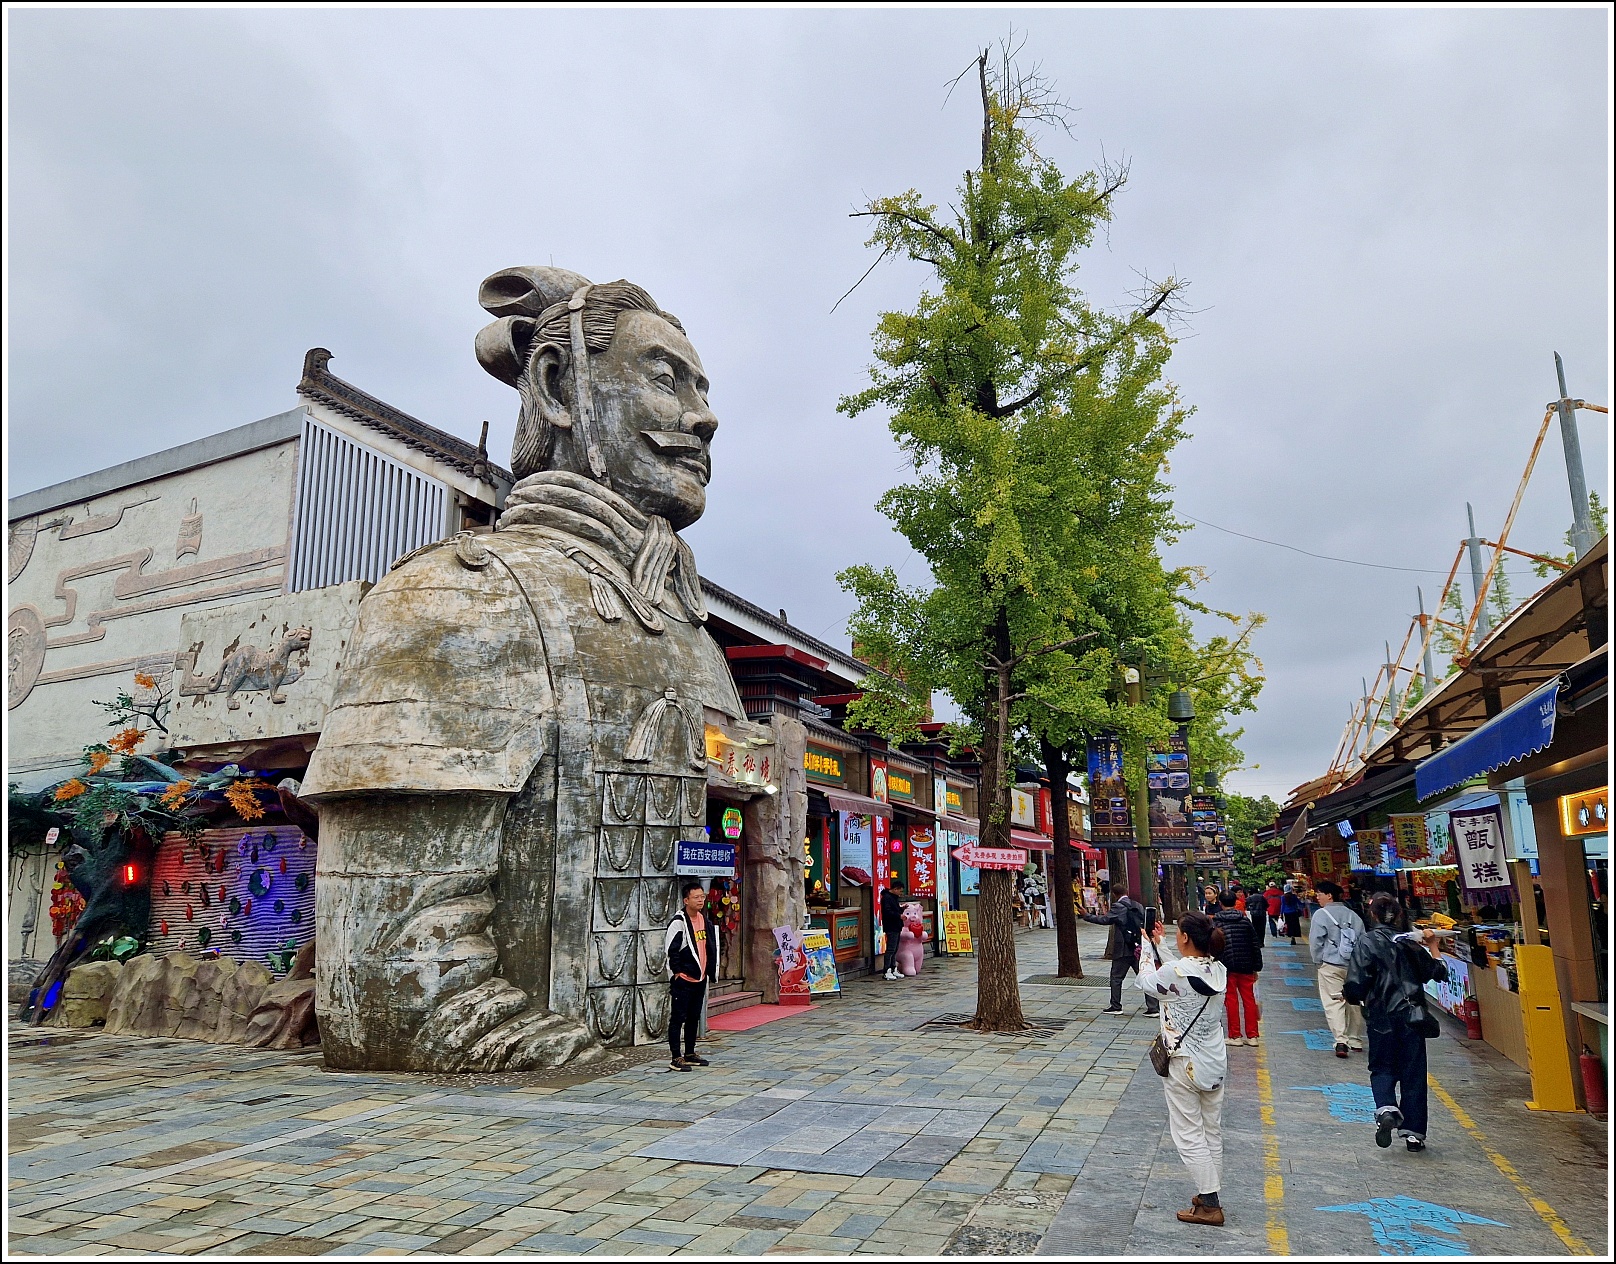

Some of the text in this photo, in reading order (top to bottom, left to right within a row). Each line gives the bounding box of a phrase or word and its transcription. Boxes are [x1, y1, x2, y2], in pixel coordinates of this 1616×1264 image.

[1456, 815, 1495, 828] 老李家
[682, 847, 731, 862] 我在西安很想你
[961, 847, 971, 862] 秘境
[912, 848, 934, 883] 油泼辣子
[973, 862, 1024, 872] 网红打卡地
[946, 921, 969, 935] 全国
[948, 937, 971, 951] 包邮
